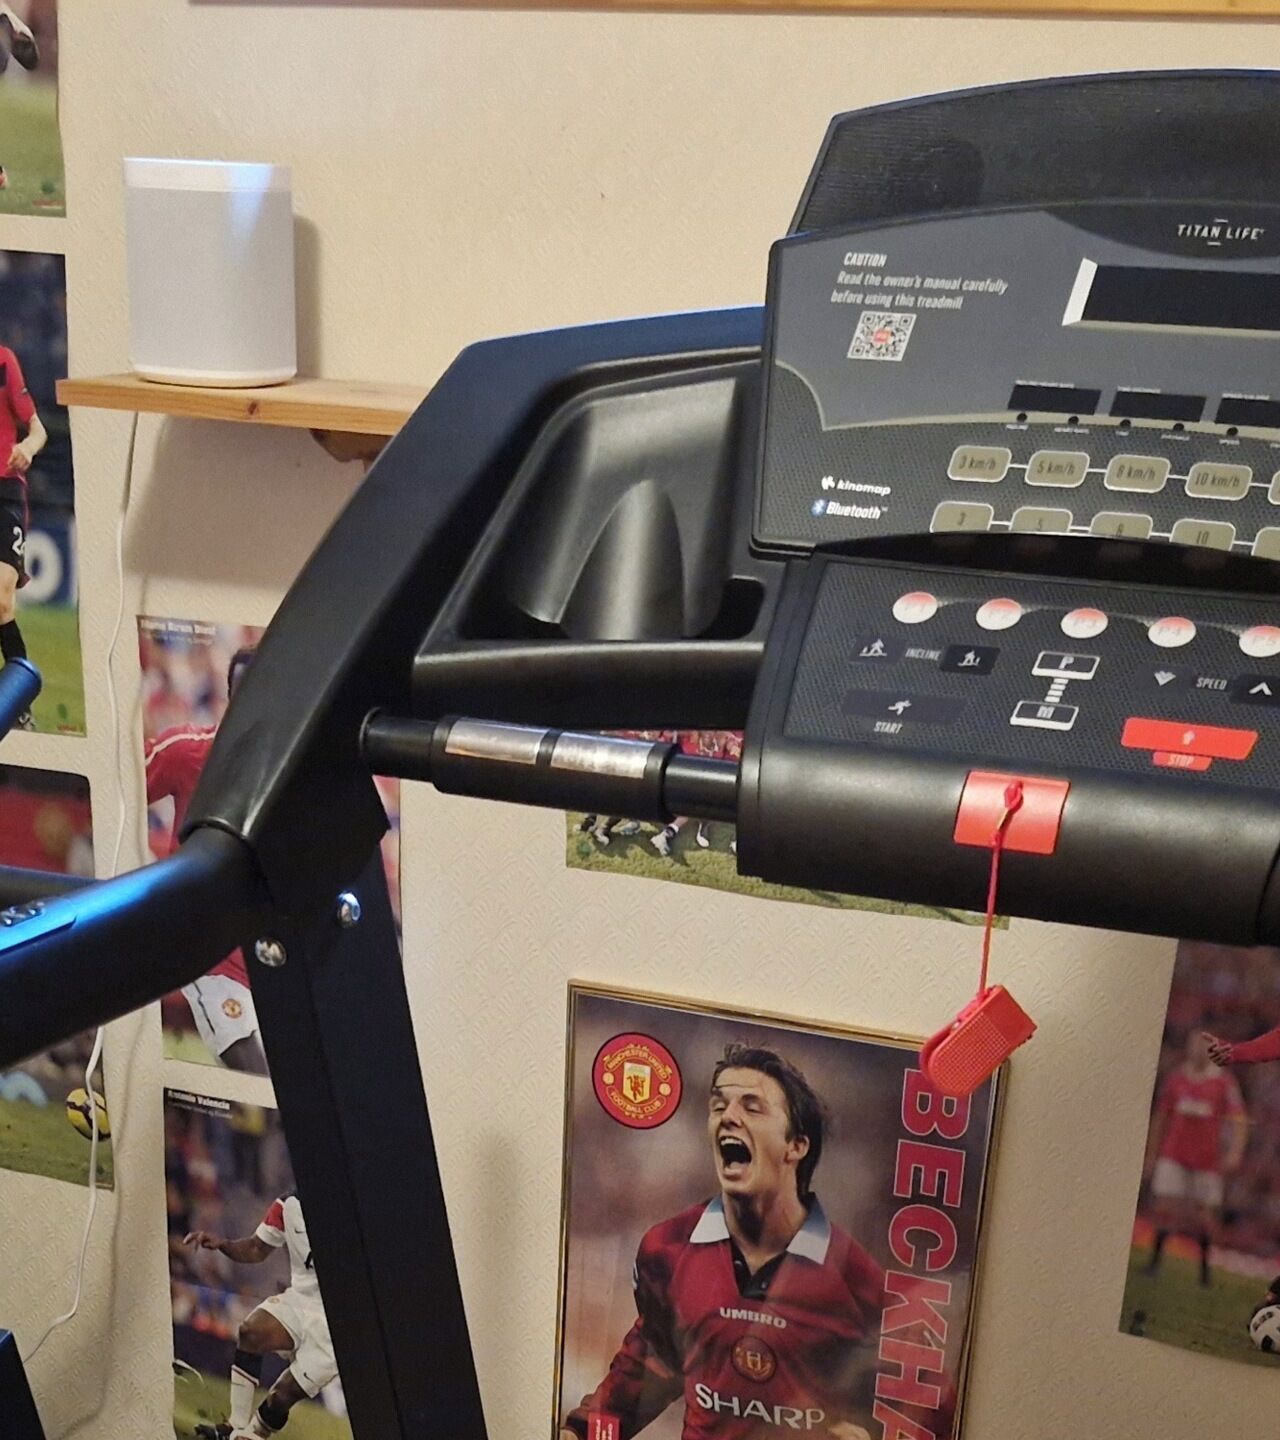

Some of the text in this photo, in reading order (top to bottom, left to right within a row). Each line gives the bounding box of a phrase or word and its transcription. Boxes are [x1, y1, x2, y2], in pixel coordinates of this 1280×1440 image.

[1178, 224, 1221, 238] TITAN
[843, 252, 888, 267] CAUTION
[836, 270, 1008, 296] Read the owner's manual carefully
[830, 289, 964, 310] before using this treadmill
[969, 457, 997, 471] km/h
[1048, 462, 1076, 475] km/h
[1127, 466, 1156, 480] km/h
[1195, 472, 1240, 488] 10 km/h
[836, 479, 892, 497] kinomap
[826, 500, 882, 520] Bluetooth
[1197, 531, 1210, 545] 10
[906, 648, 941, 661] INCLINE
[1059, 655, 1074, 669] P
[1196, 676, 1228, 690] SPEED
[1036, 705, 1056, 719] M
[873, 721, 903, 734] START
[720, 1306, 787, 1329] UMBRO
[695, 1383, 826, 1430] SHARP
